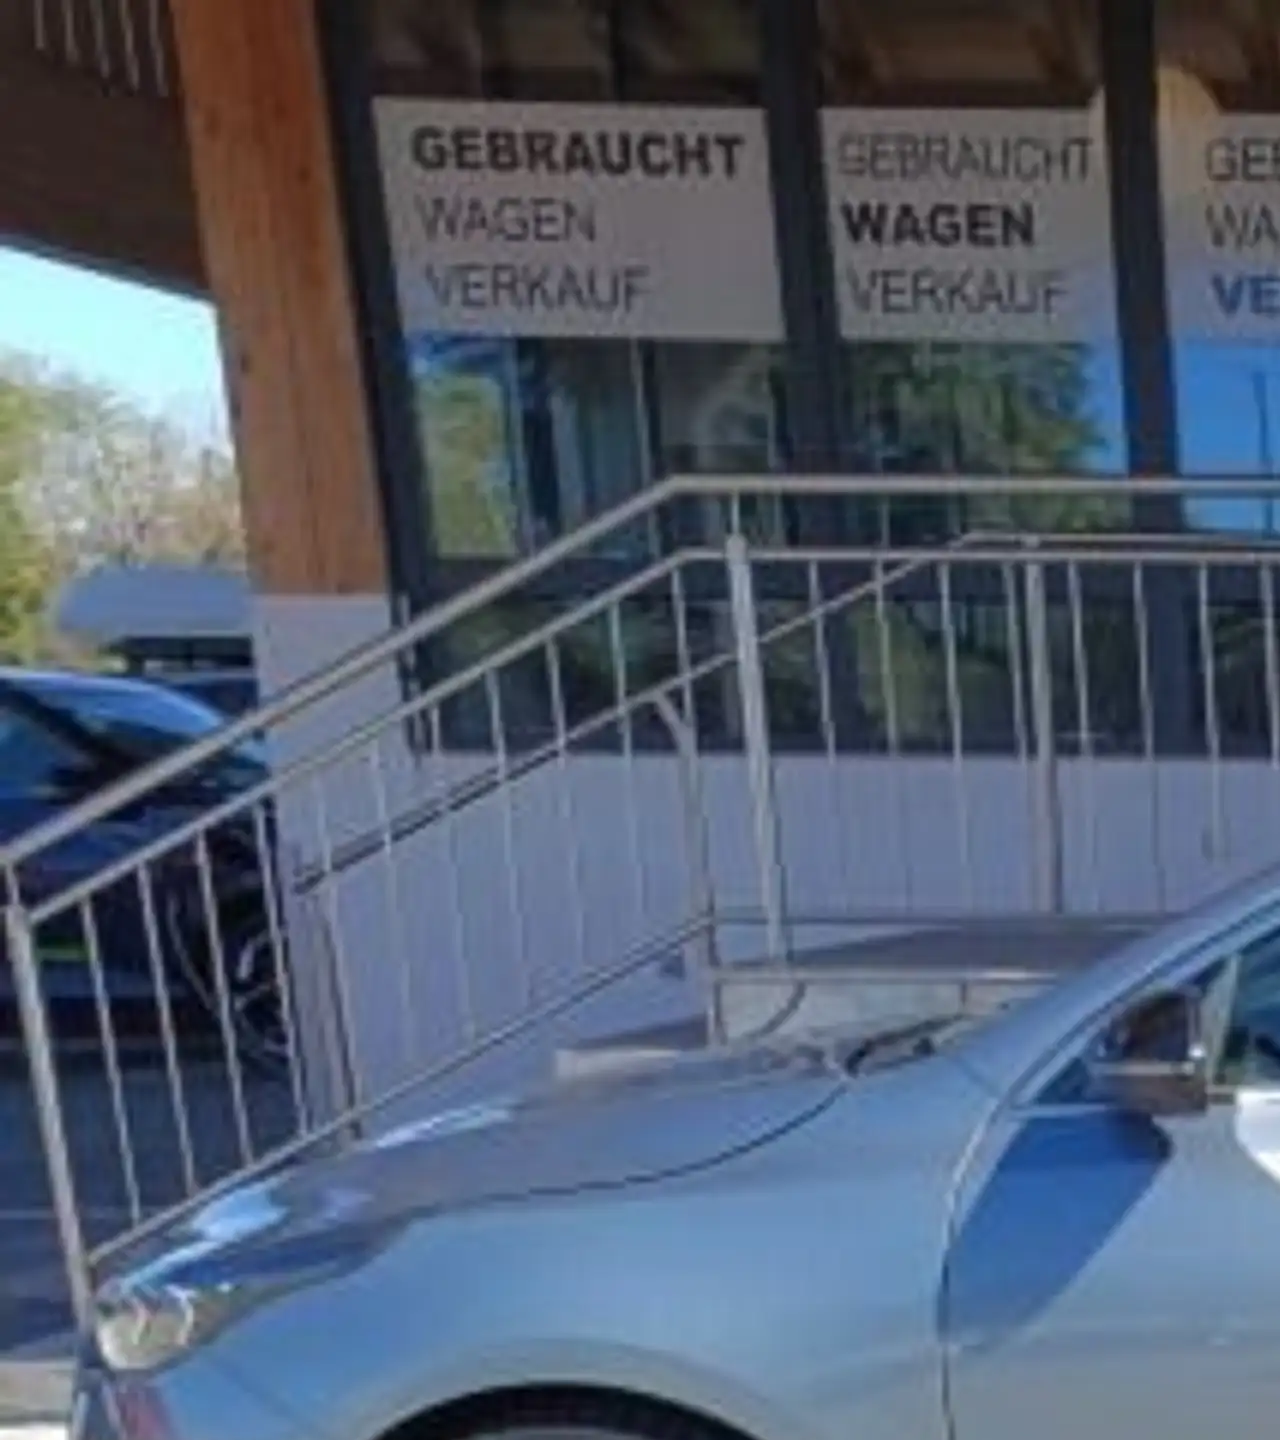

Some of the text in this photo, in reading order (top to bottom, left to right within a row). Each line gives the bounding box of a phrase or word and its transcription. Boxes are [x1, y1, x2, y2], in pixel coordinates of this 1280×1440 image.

[411, 125, 745, 179] GEBRAUCHT
[837, 132, 1093, 182] GEBRAUCHT
[416, 197, 597, 243] WAGEN
[840, 203, 1034, 247] WAGEN
[424, 264, 650, 311] VERKAUF
[846, 267, 1068, 315] VERKAUF
